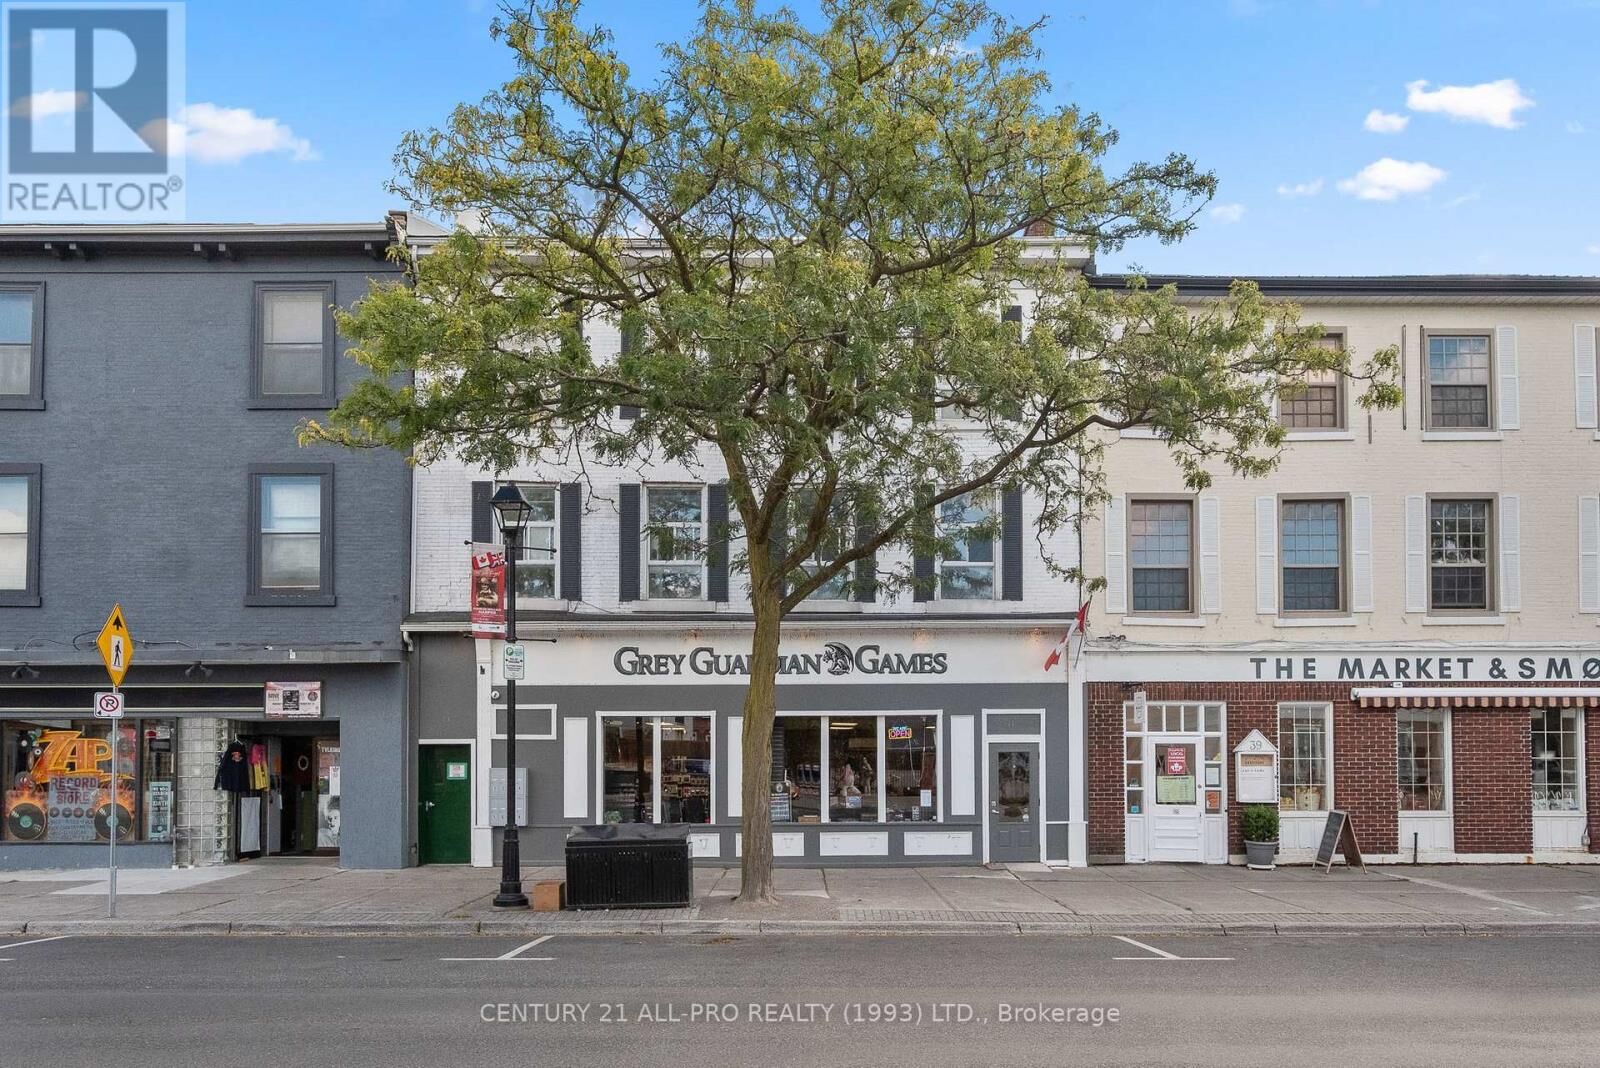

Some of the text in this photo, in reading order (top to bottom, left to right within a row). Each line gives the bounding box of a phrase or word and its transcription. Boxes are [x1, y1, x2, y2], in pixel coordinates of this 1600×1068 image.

[614, 645, 948, 675] GREY GUAIAN GAMES
[1250, 658, 1316, 679] THE
[1338, 658, 1474, 679] MARKET
[1488, 657, 1508, 679] &
[1250, 740, 1262, 750] 39
[30, 729, 136, 785] ZAP
[50, 777, 98, 791] RECORD
[56, 791, 89, 804] STORE
